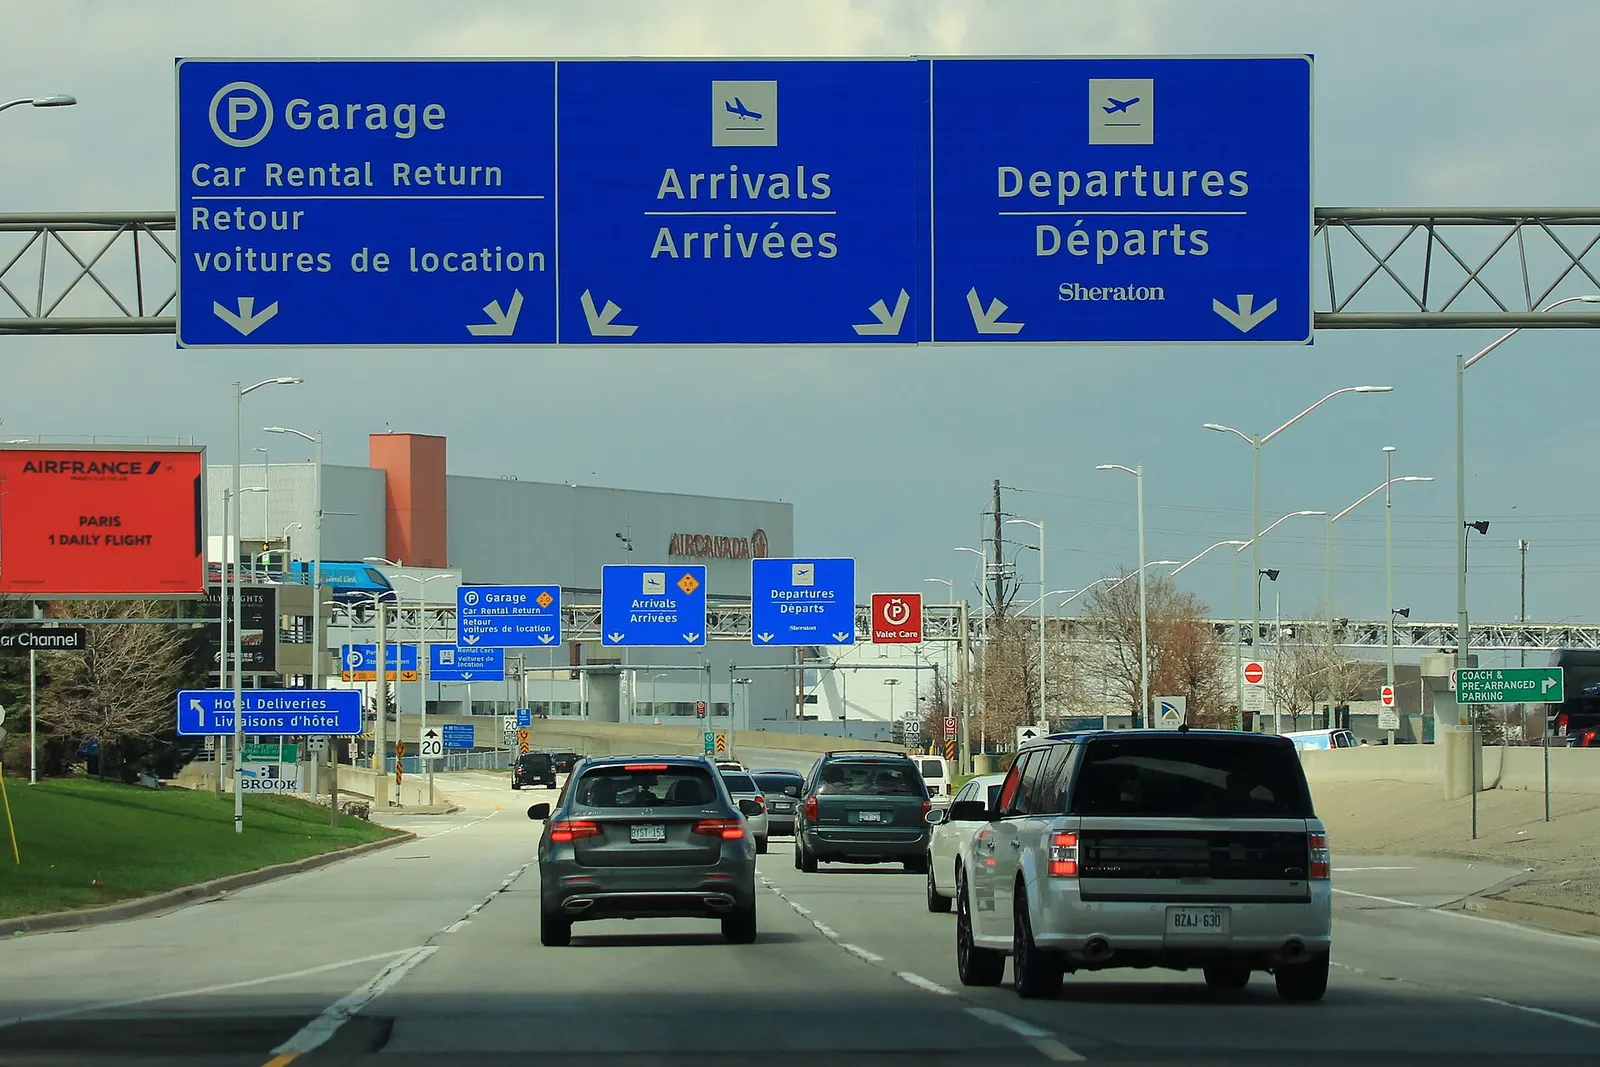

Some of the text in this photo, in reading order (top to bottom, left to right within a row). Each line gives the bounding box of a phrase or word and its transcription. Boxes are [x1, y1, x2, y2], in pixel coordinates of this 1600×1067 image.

[285, 98, 447, 139] Garage
[191, 161, 503, 187] Car Rental Return
[656, 164, 832, 200] Arrivals
[997, 164, 1250, 206] Departures
[192, 206, 305, 230] Retour
[650, 221, 839, 259] Arrivées
[1035, 219, 1210, 265] Départs
[194, 246, 546, 272] voitures de location
[1058, 282, 1165, 301] Sheraton
[79, 516, 121, 527] PARIS
[48, 534, 153, 546] 1 DAILY FLIGHT
[485, 593, 527, 604] Garage
[771, 589, 835, 600] Departures
[631, 598, 677, 608] Arrivals
[462, 607, 477, 615] Car
[481, 607, 509, 615] Rental
[780, 603, 825, 615] Départs
[463, 618, 491, 626] Retour
[630, 612, 678, 623] Arrivées
[463, 624, 551, 633] voitures de location
[875, 630, 919, 638] Valet Care
[18, 632, 78, 647] Channel
[1461, 670, 1503, 680] COACH &
[1461, 680, 1536, 691] PRE-ARRANGED
[1461, 691, 1503, 701] PARKING
[257, 698, 327, 709] Deliveries
[214, 714, 339, 727] Livaisons d'hôtel
[505, 720, 518, 730] 20
[905, 722, 919, 732] 20
[422, 740, 441, 755] 20
[1203, 913, 1221, 928] 630
